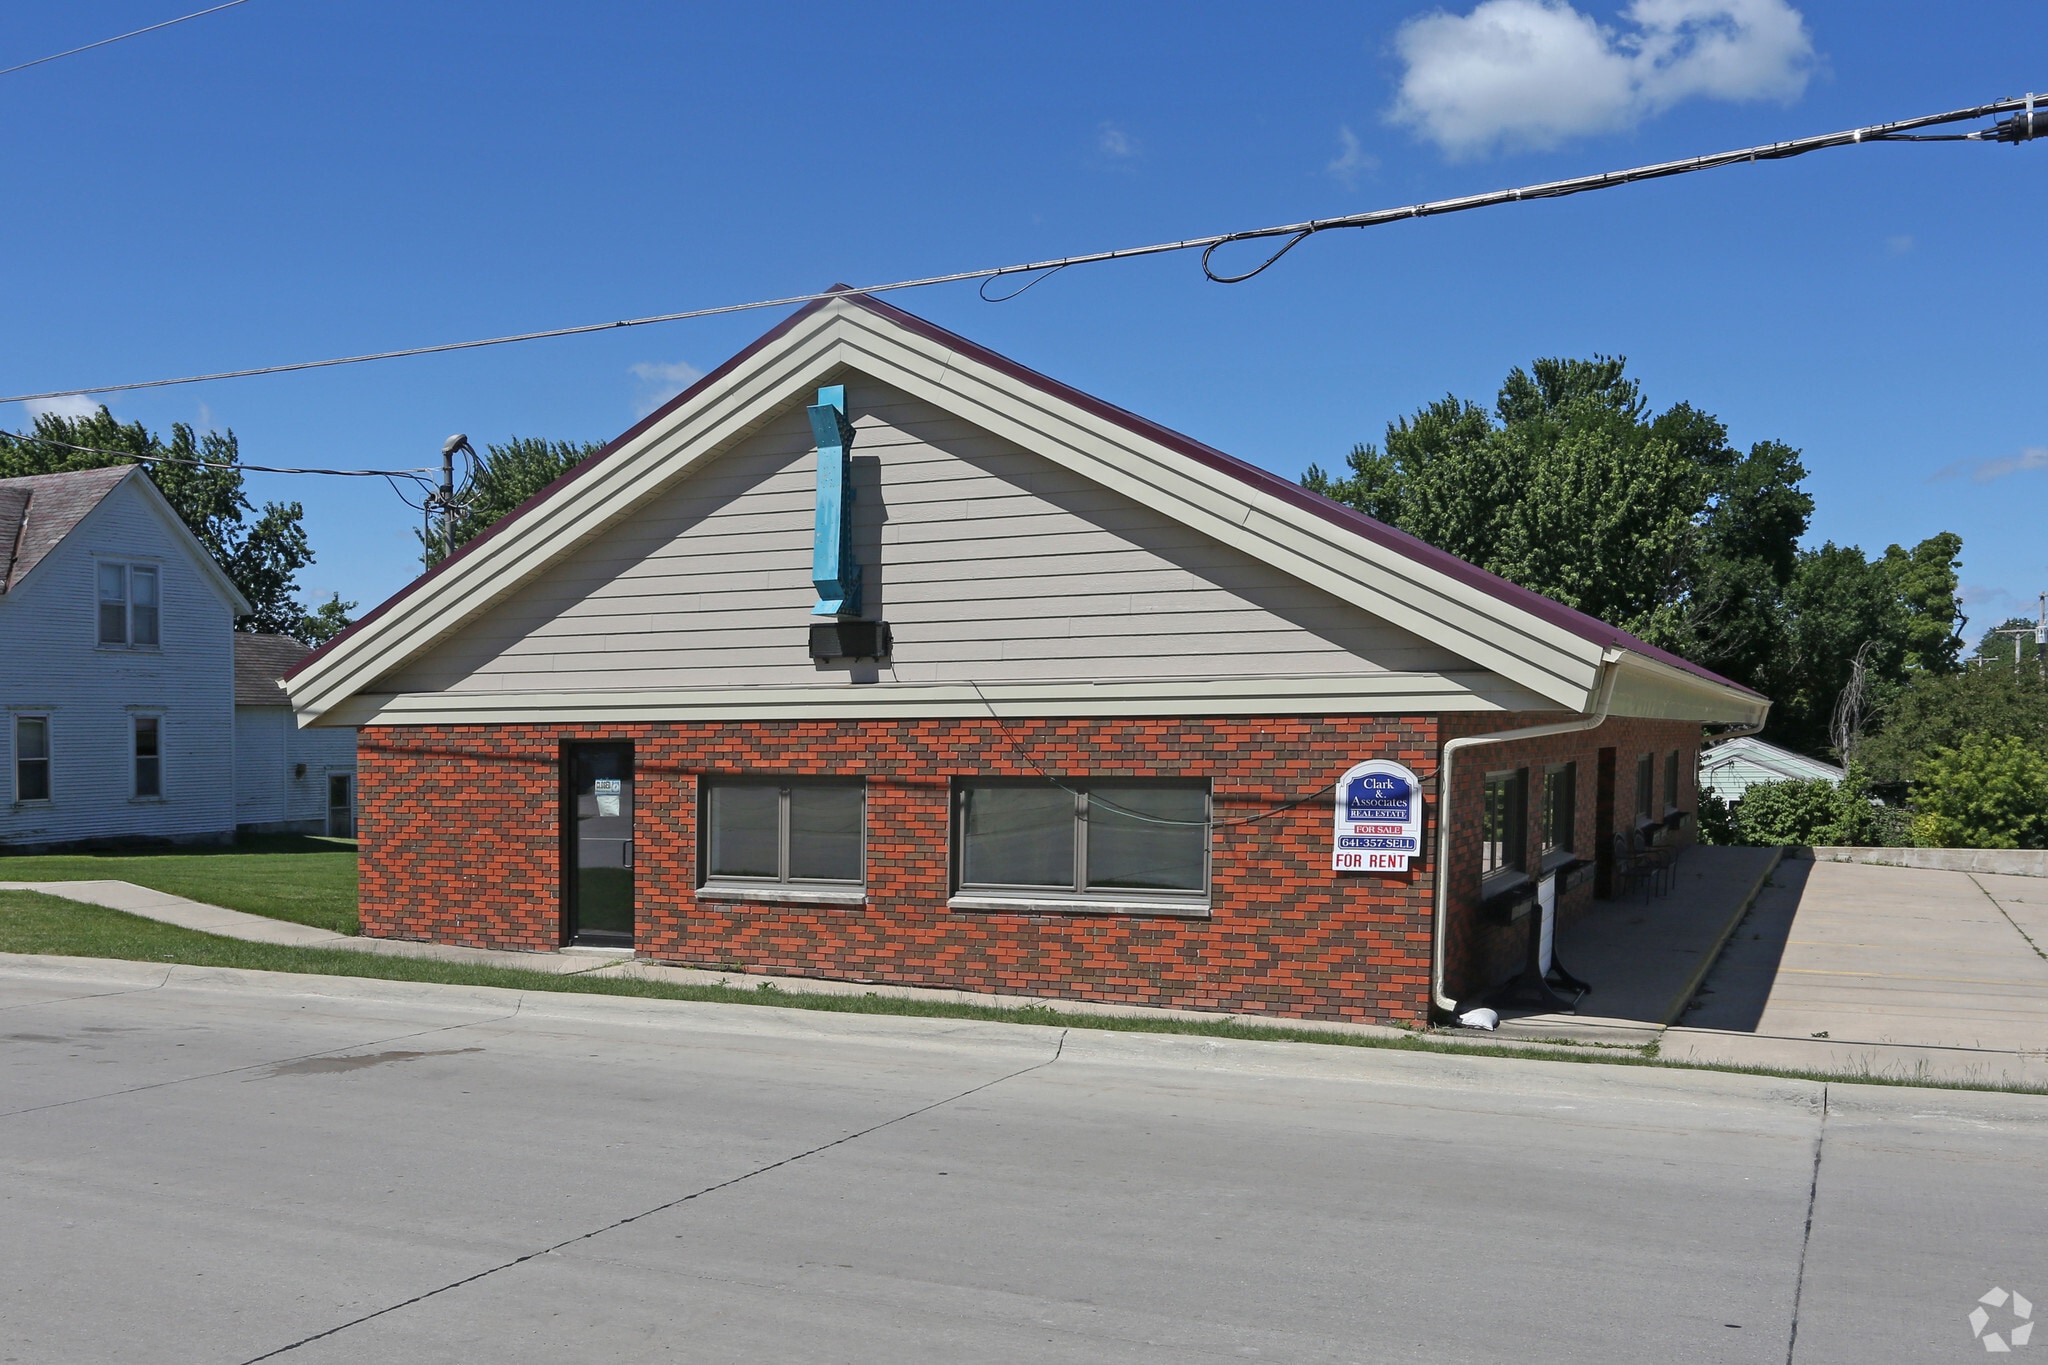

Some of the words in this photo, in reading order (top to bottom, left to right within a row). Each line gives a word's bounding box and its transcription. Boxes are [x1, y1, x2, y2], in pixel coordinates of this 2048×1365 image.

[1363, 778, 1394, 789] Clark
[1375, 789, 1383, 798] &
[1351, 796, 1408, 807] Associates
[1377, 826, 1401, 834] SALE
[1341, 838, 1413, 848] 641-357-SELL
[1336, 854, 1362, 868] FOR
[1369, 854, 1405, 868] RENT
